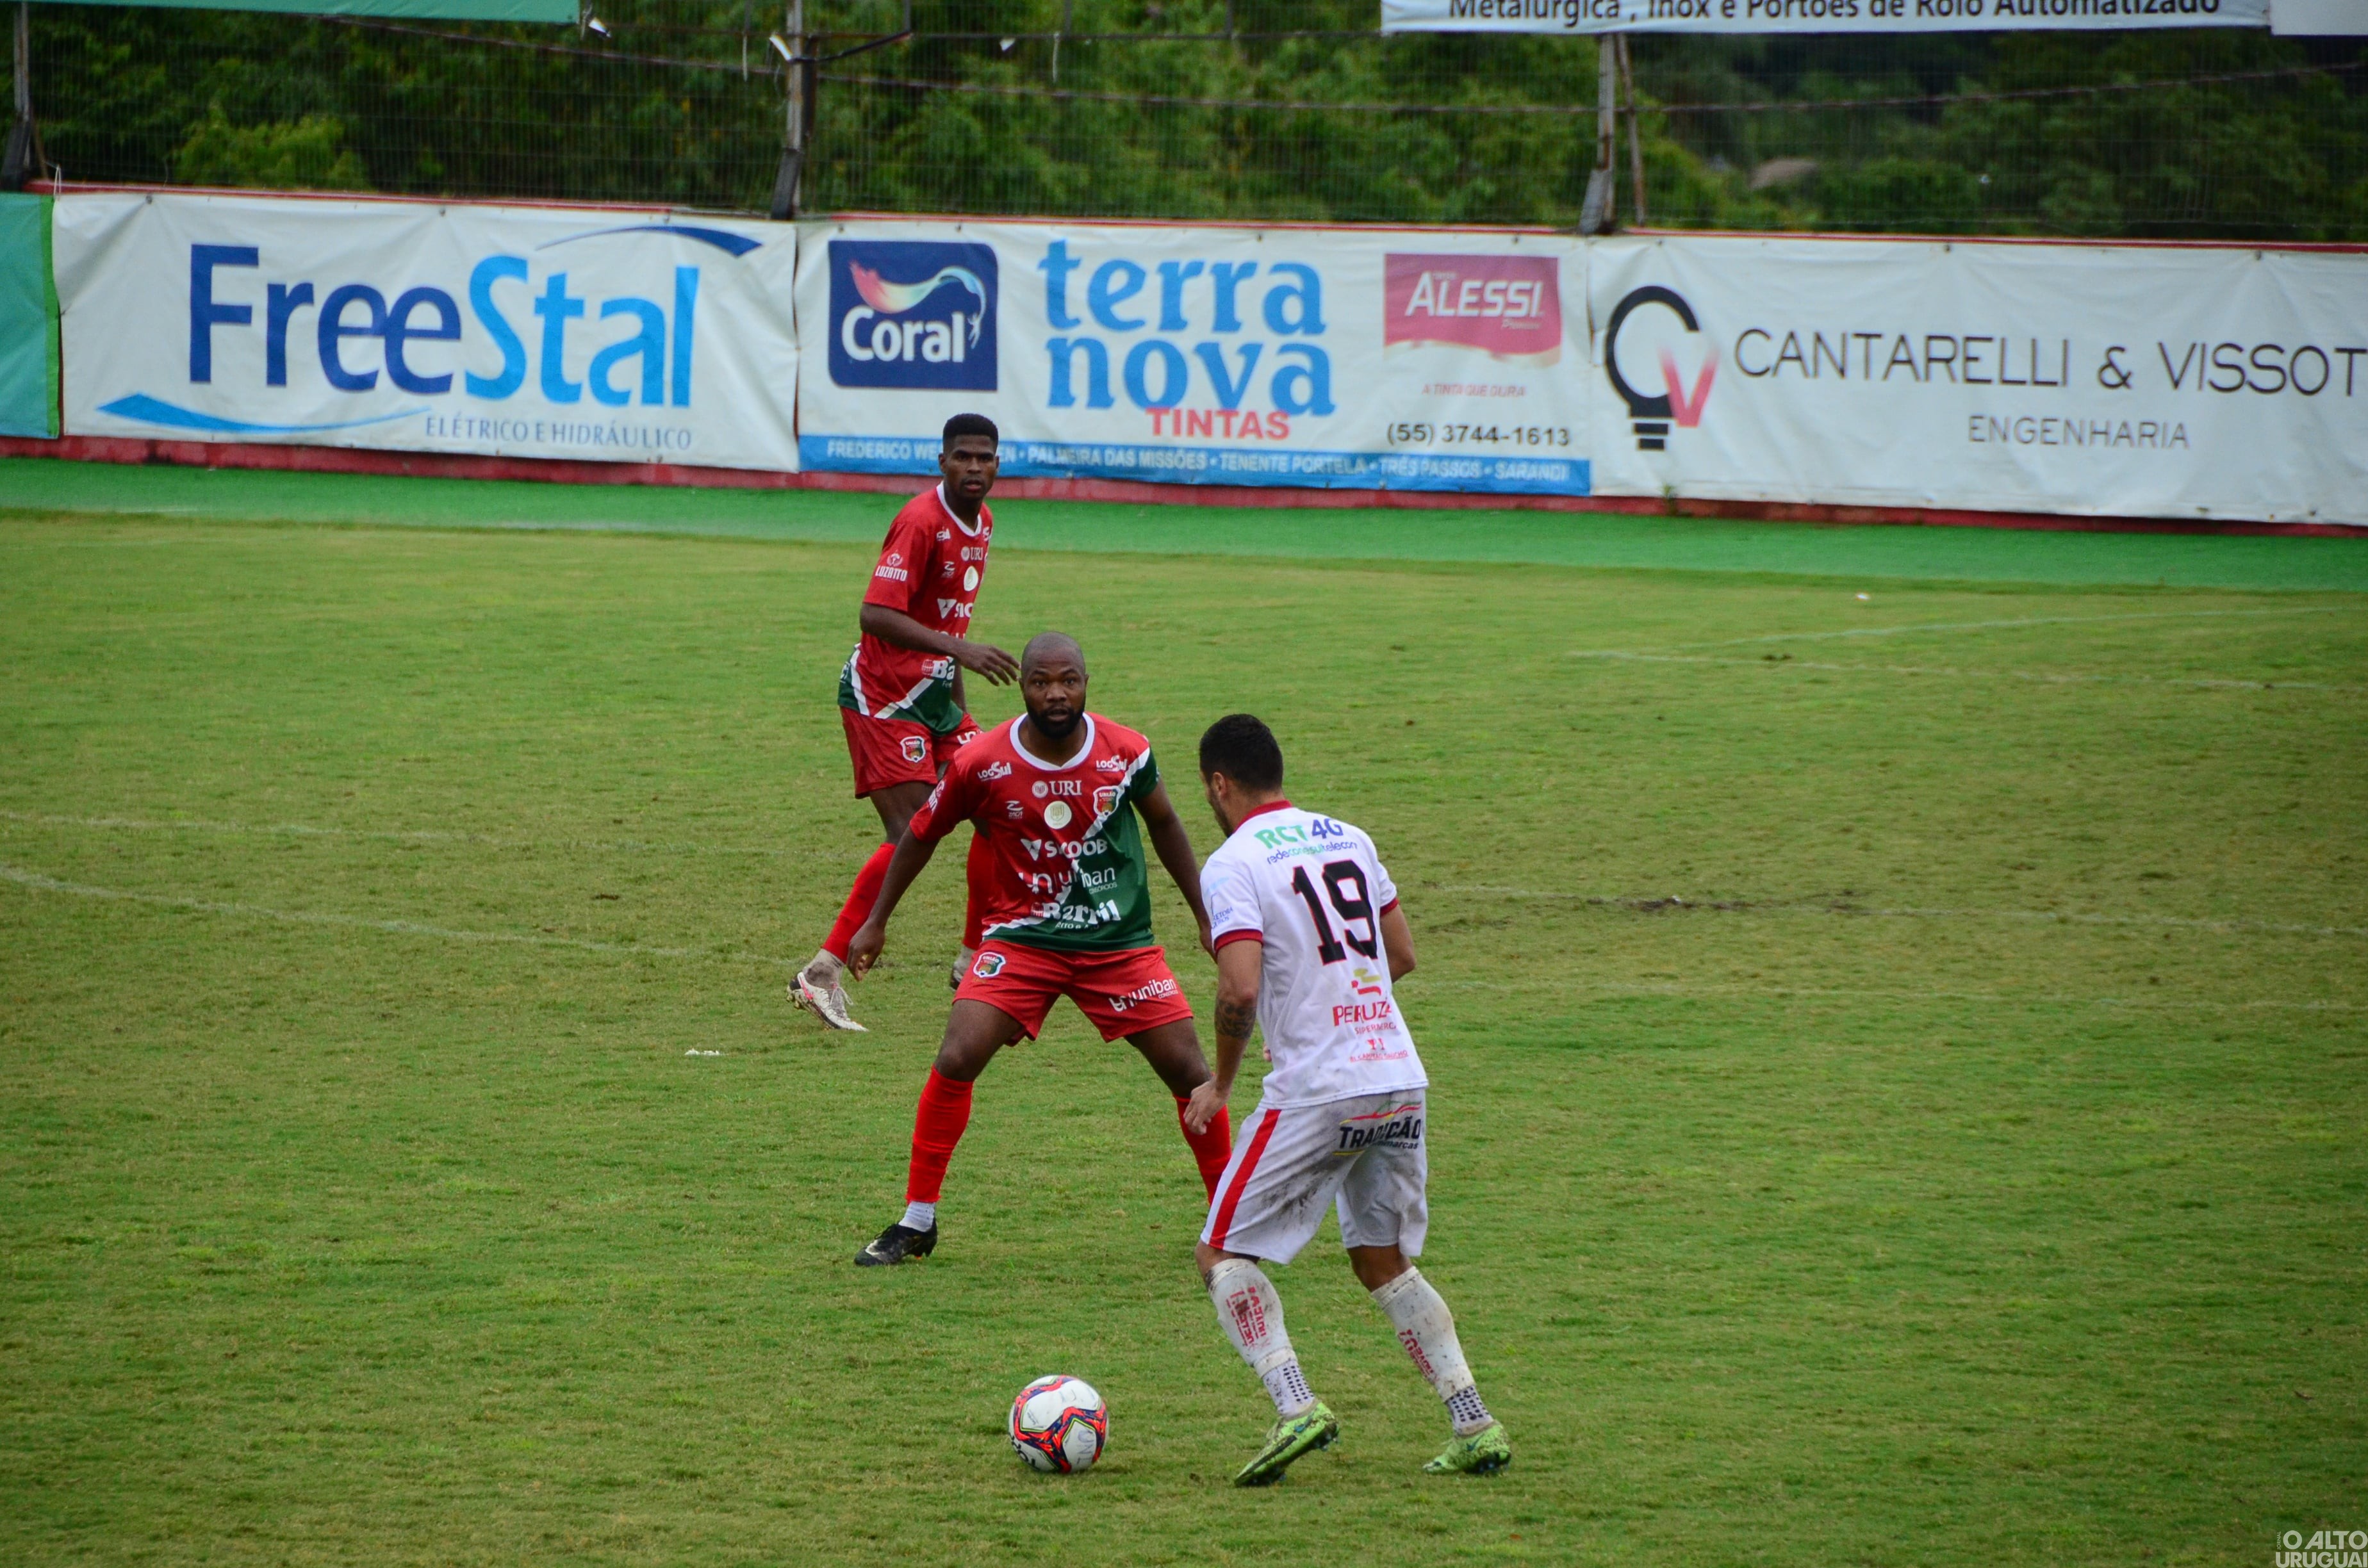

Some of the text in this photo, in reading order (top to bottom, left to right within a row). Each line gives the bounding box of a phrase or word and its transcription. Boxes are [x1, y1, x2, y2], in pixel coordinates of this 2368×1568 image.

[1721, 0, 1735, 18] e
[1869, 0, 1904, 17] de
[1917, 0, 1984, 17] Rolo
[1993, 0, 2219, 17] Automatizado
[1037, 239, 1328, 336] terra
[1404, 272, 1543, 318] ALESSI
[189, 243, 700, 409] FreeStal
[841, 307, 965, 364] Coral
[1047, 338, 1336, 416] nova
[1734, 327, 2368, 397] CANTARELLI & VISSOT
[425, 412, 692, 449] ELÉTRICO E HIDRÁULICO
[1146, 409, 1290, 441] TINTAS
[1386, 422, 1570, 447] (55) 3744-1613
[1968, 414, 2189, 450] ENGENHARIA
[827, 439, 912, 461] FREDERICO
[1027, 448, 1103, 467] PALMEIRA
[1105, 450, 1134, 468] DAS
[1219, 453, 1290, 473] TENENTE
[1291, 455, 1366, 475] PORTELA
[1421, 460, 1483, 479] PASSOS
[970, 546, 984, 560] URI
[875, 566, 908, 582] LUZATTO
[1049, 780, 1082, 796] URI
[1254, 818, 1344, 849] RCT 4G
[1291, 859, 1378, 966] 19
